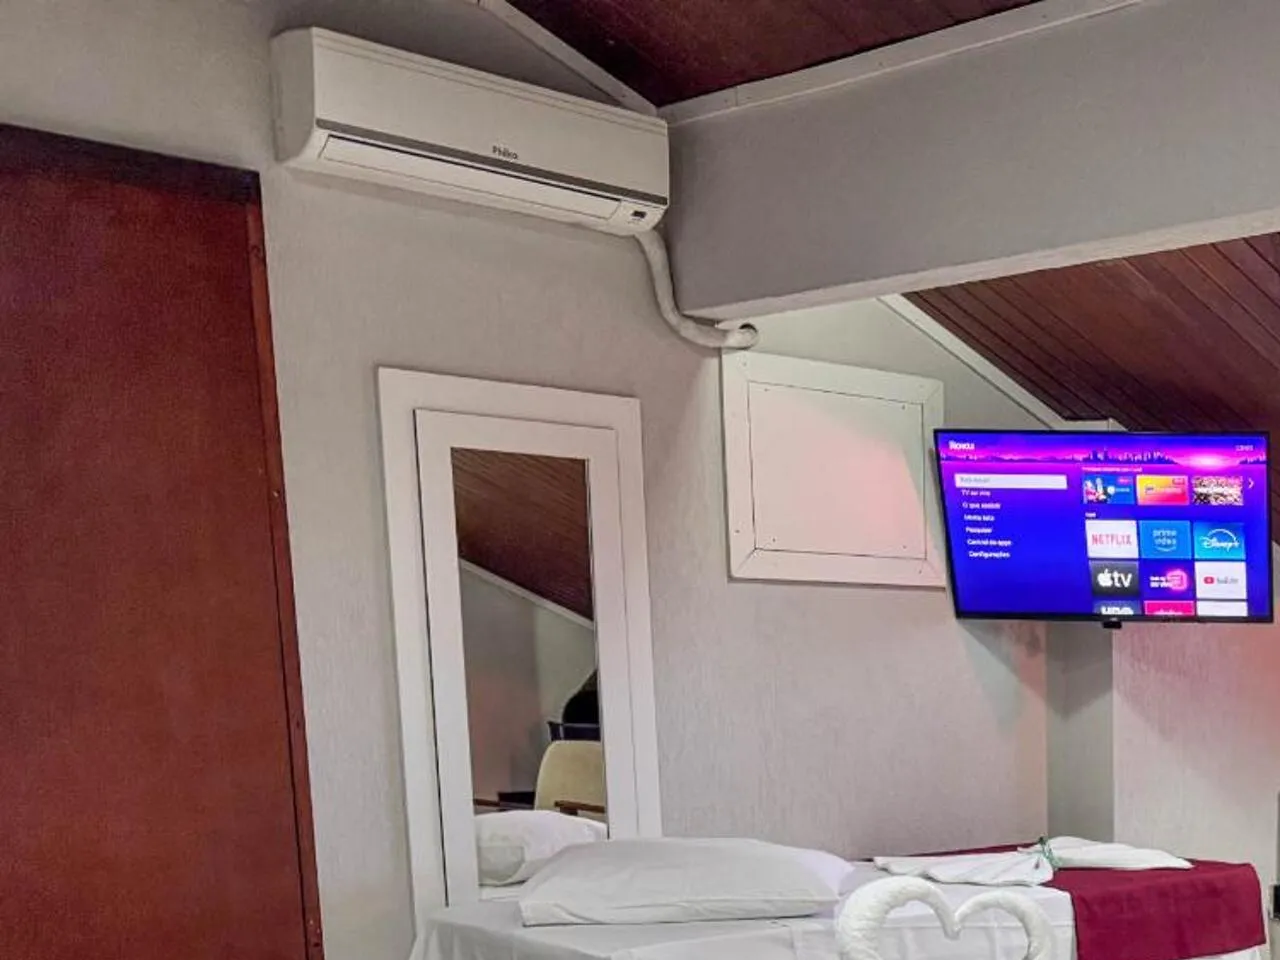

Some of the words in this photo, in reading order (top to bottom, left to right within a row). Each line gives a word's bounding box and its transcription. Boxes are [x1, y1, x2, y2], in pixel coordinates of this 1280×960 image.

[1152, 529, 1177, 538] prime
[1091, 533, 1132, 546] NETFLIX
[1154, 536, 1177, 546] video
[1113, 570, 1133, 588] tv
